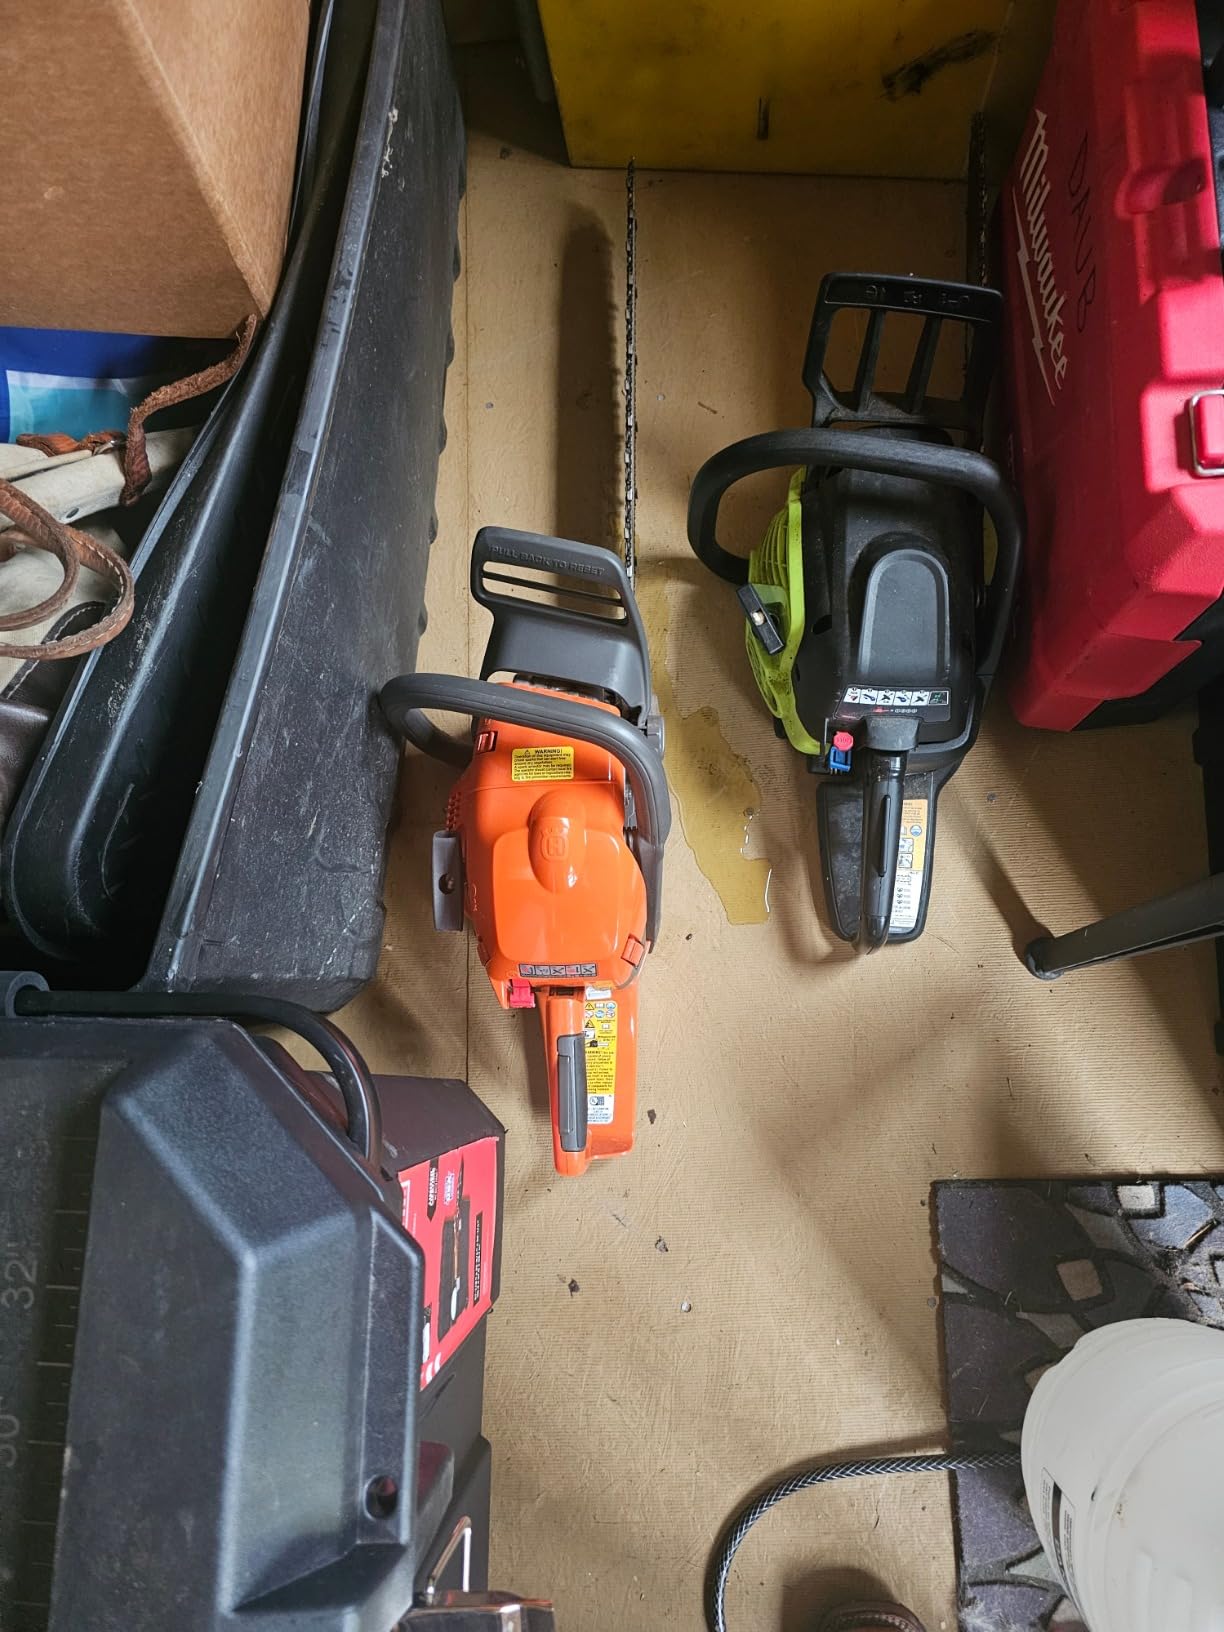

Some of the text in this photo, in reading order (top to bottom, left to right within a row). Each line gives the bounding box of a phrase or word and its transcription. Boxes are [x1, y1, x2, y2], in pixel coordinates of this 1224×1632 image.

[1020, 109, 1069, 389] Milwaukee
[492, 545, 605, 575] PULL BACK TO RESET
